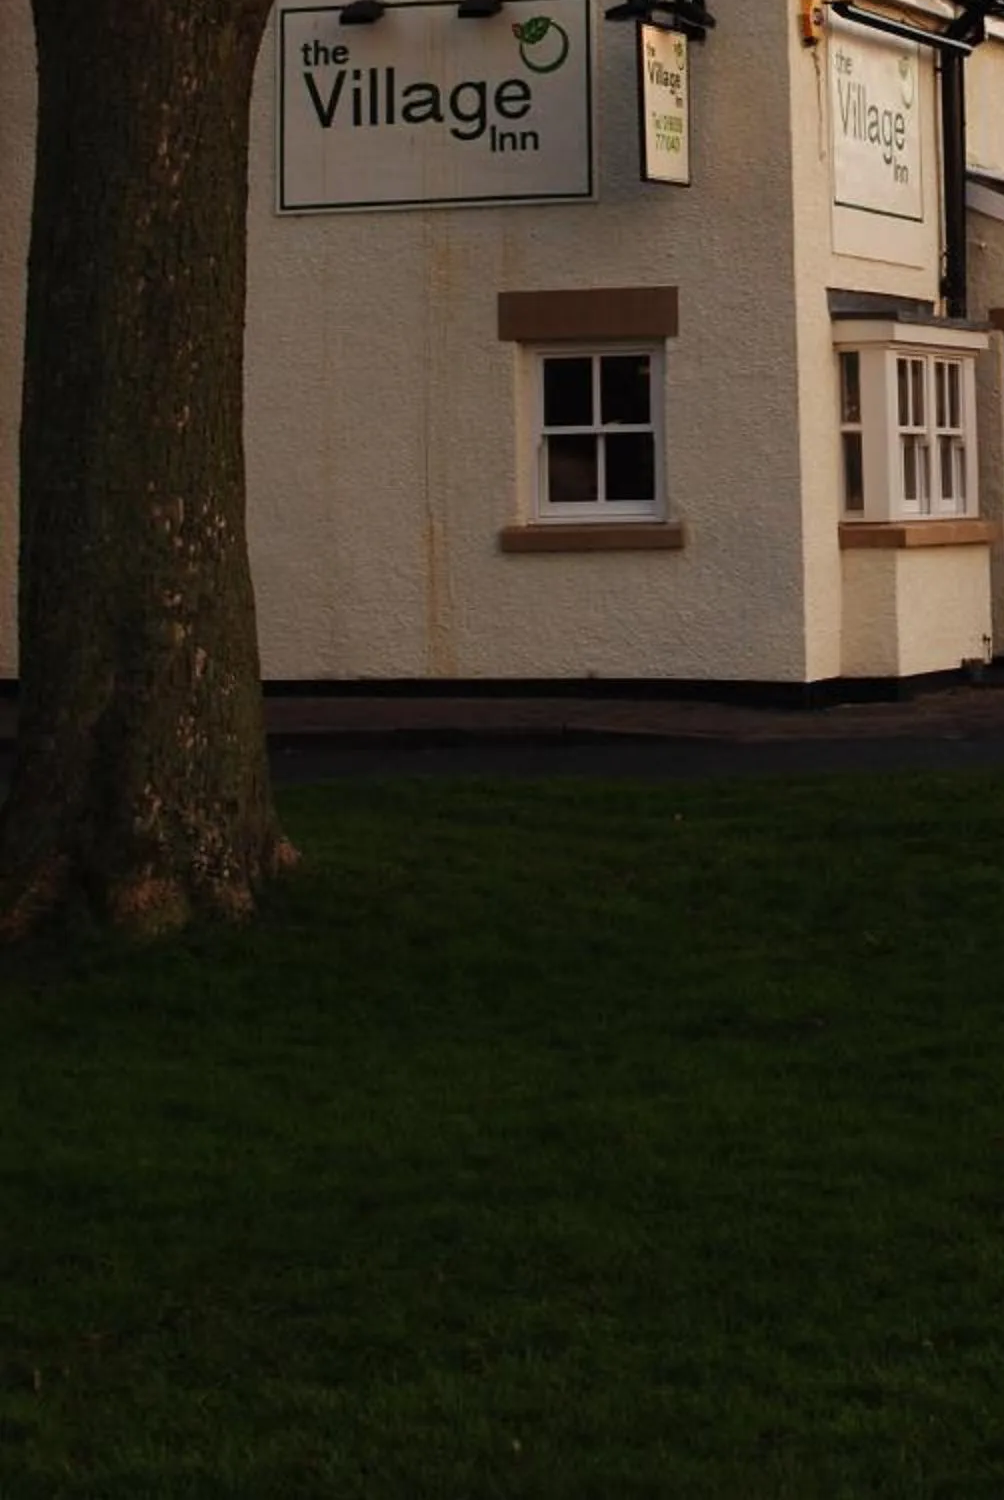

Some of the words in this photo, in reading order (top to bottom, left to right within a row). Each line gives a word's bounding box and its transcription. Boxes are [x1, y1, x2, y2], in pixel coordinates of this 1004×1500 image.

[301, 40, 349, 67] the
[835, 49, 853, 76] the
[303, 67, 532, 140] Village
[837, 77, 905, 165] Village
[489, 124, 540, 153] Inn
[893, 155, 909, 184] Inn
